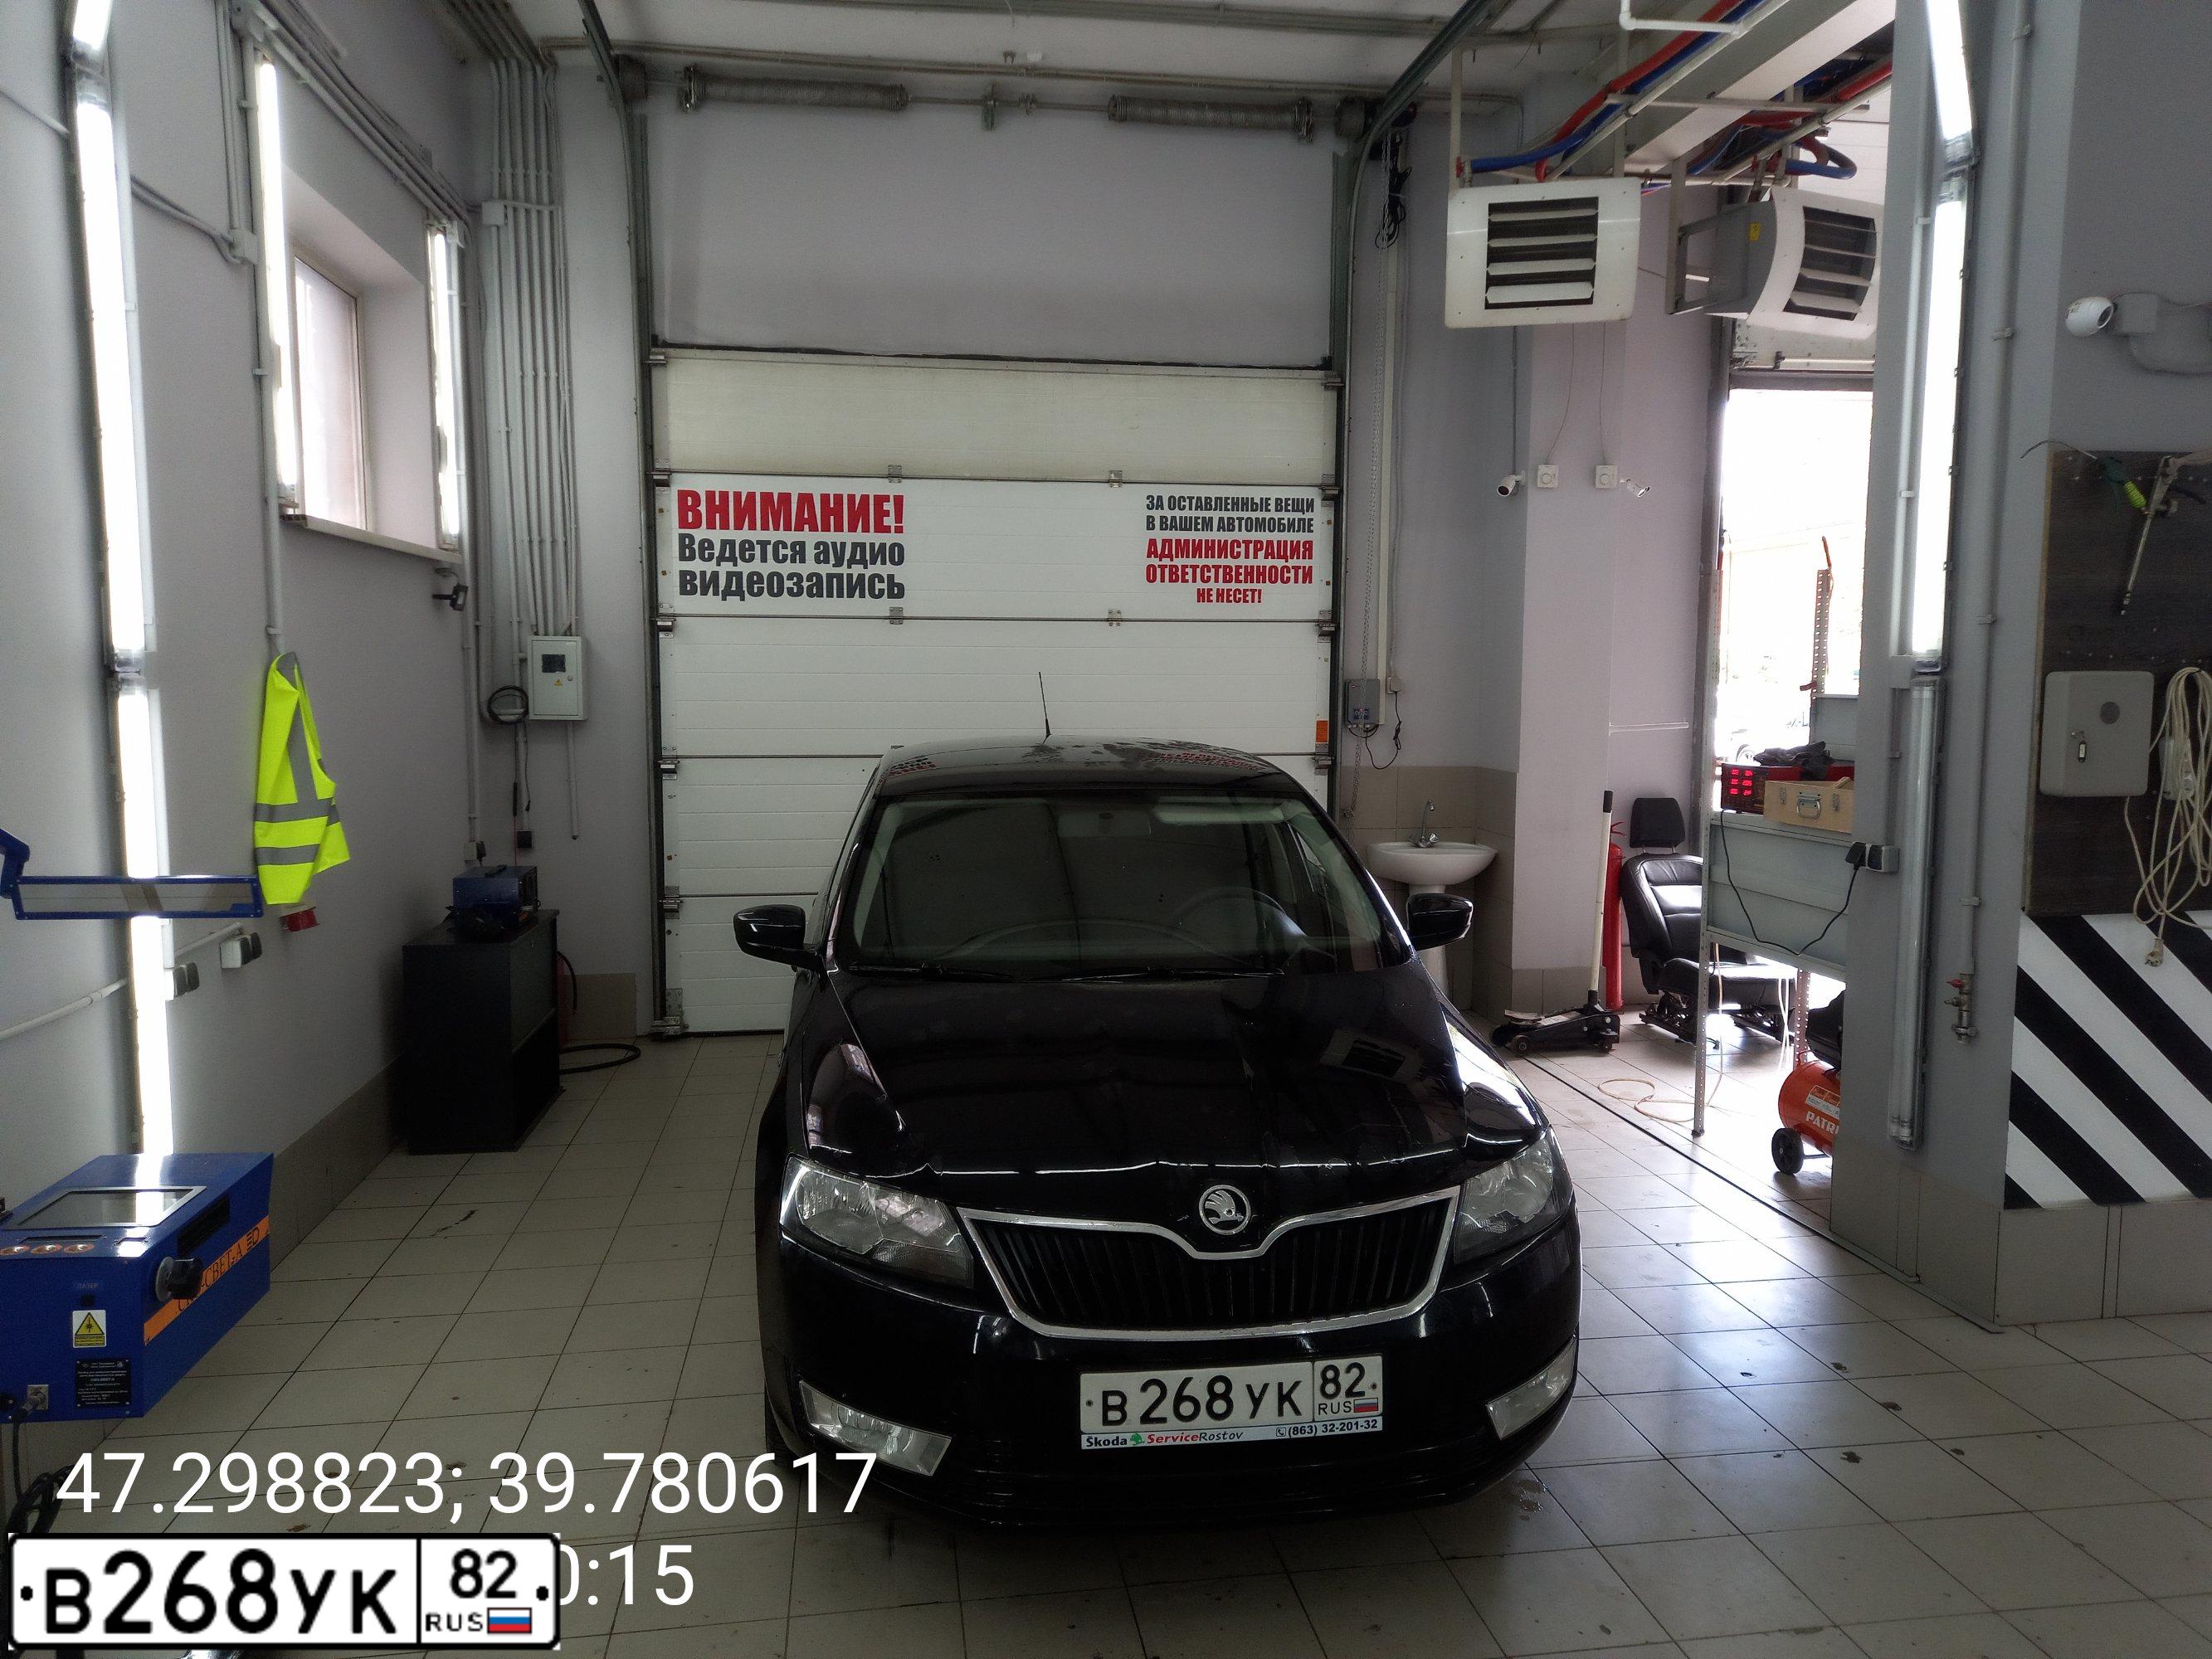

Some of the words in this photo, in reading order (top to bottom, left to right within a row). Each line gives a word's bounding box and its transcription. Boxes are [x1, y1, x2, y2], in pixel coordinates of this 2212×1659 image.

[677, 489, 904, 533] ВНИМАНИЕ!
[1146, 495, 1164, 511] ЗА
[1167, 495, 1271, 513] ОСТАВЛЕННЫЕ
[1274, 498, 1314, 514] ВЕЩИ
[1146, 515, 1156, 531] В
[1160, 515, 1213, 532] ВАШЕМ
[1216, 517, 1313, 533] АВТОМОБИЛЕ
[678, 533, 806, 567] Ведется
[813, 540, 905, 569] аудио
[1146, 538, 1313, 562] АДМИНИСТРАЦИЯ
[679, 570, 905, 601] видеозапись
[1146, 564, 1313, 584] ОТВЕТСТВЕННОСТИ
[1196, 588, 1213, 603] НЕ
[1216, 588, 1262, 604] НЕСЕТ!
[1320, 1362, 1366, 1399] 82
[1318, 1401, 1352, 1415] RUS
[1086, 1436, 1128, 1447] Škoda
[1289, 1424, 1318, 1438] (863)
[1321, 1419, 1378, 1433] 32-201-32
